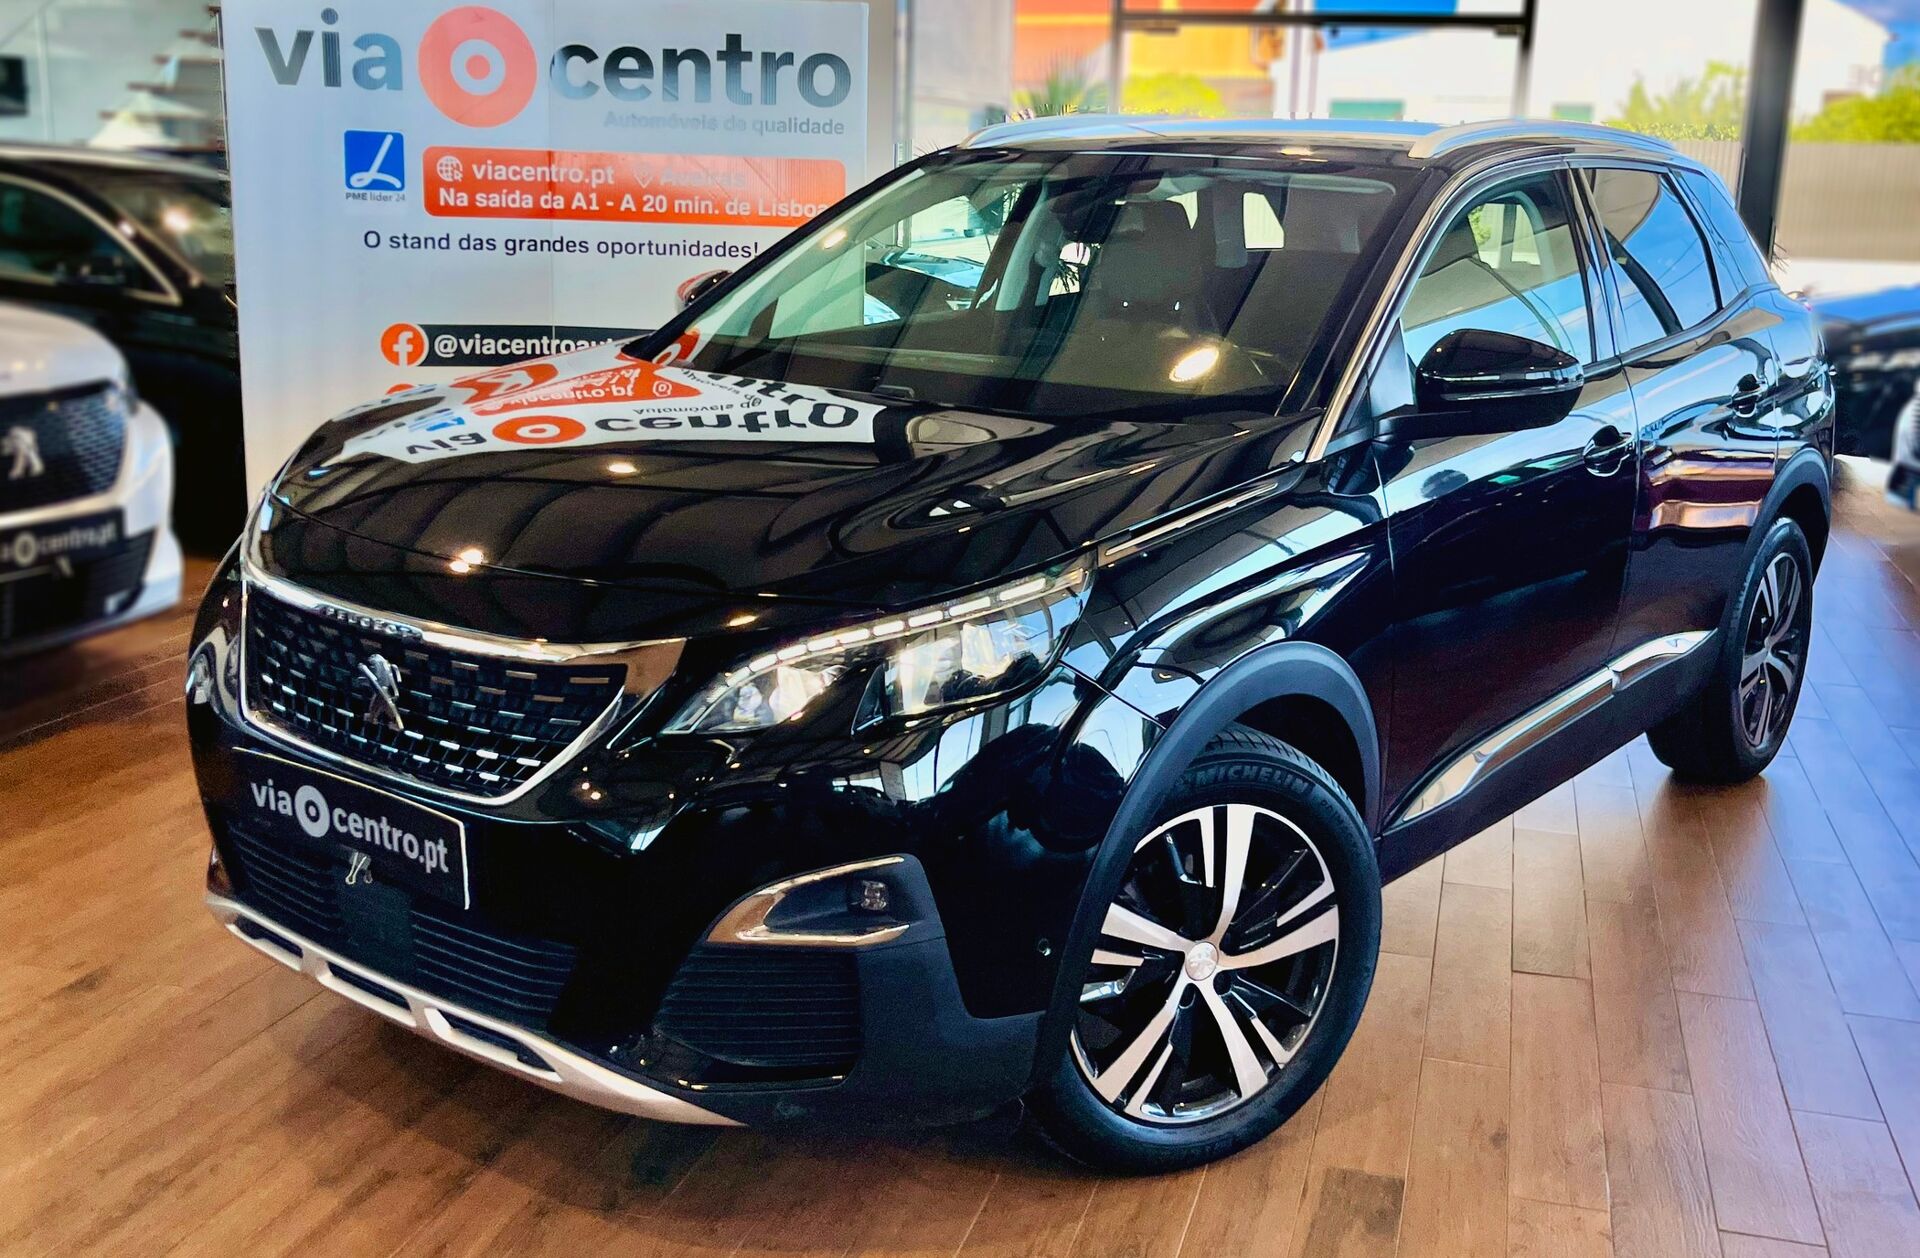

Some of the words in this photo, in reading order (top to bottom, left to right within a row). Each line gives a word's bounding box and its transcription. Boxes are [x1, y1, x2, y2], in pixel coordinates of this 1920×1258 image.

[254, 7, 403, 91] via
[549, 33, 851, 108] centro
[752, 115, 845, 136] qualidade
[472, 160, 615, 187] viacentro.pt
[345, 192, 368, 200] PME
[439, 188, 469, 207] Na
[475, 190, 534, 209] saída
[540, 191, 565, 210] da
[571, 192, 599, 211] A1
[620, 194, 637, 212] A
[642, 194, 667, 213] 20
[673, 196, 719, 215] min.
[725, 199, 751, 216] de
[363, 230, 381, 249] O
[389, 232, 450, 250] stand
[458, 233, 497, 251] das
[504, 235, 589, 256] grandes
[596, 239, 759, 258] oportunidades!
[1195, 764, 1309, 794] MICHELIN
[251, 778, 293, 816] via
[332, 807, 449, 874] centro.pt
